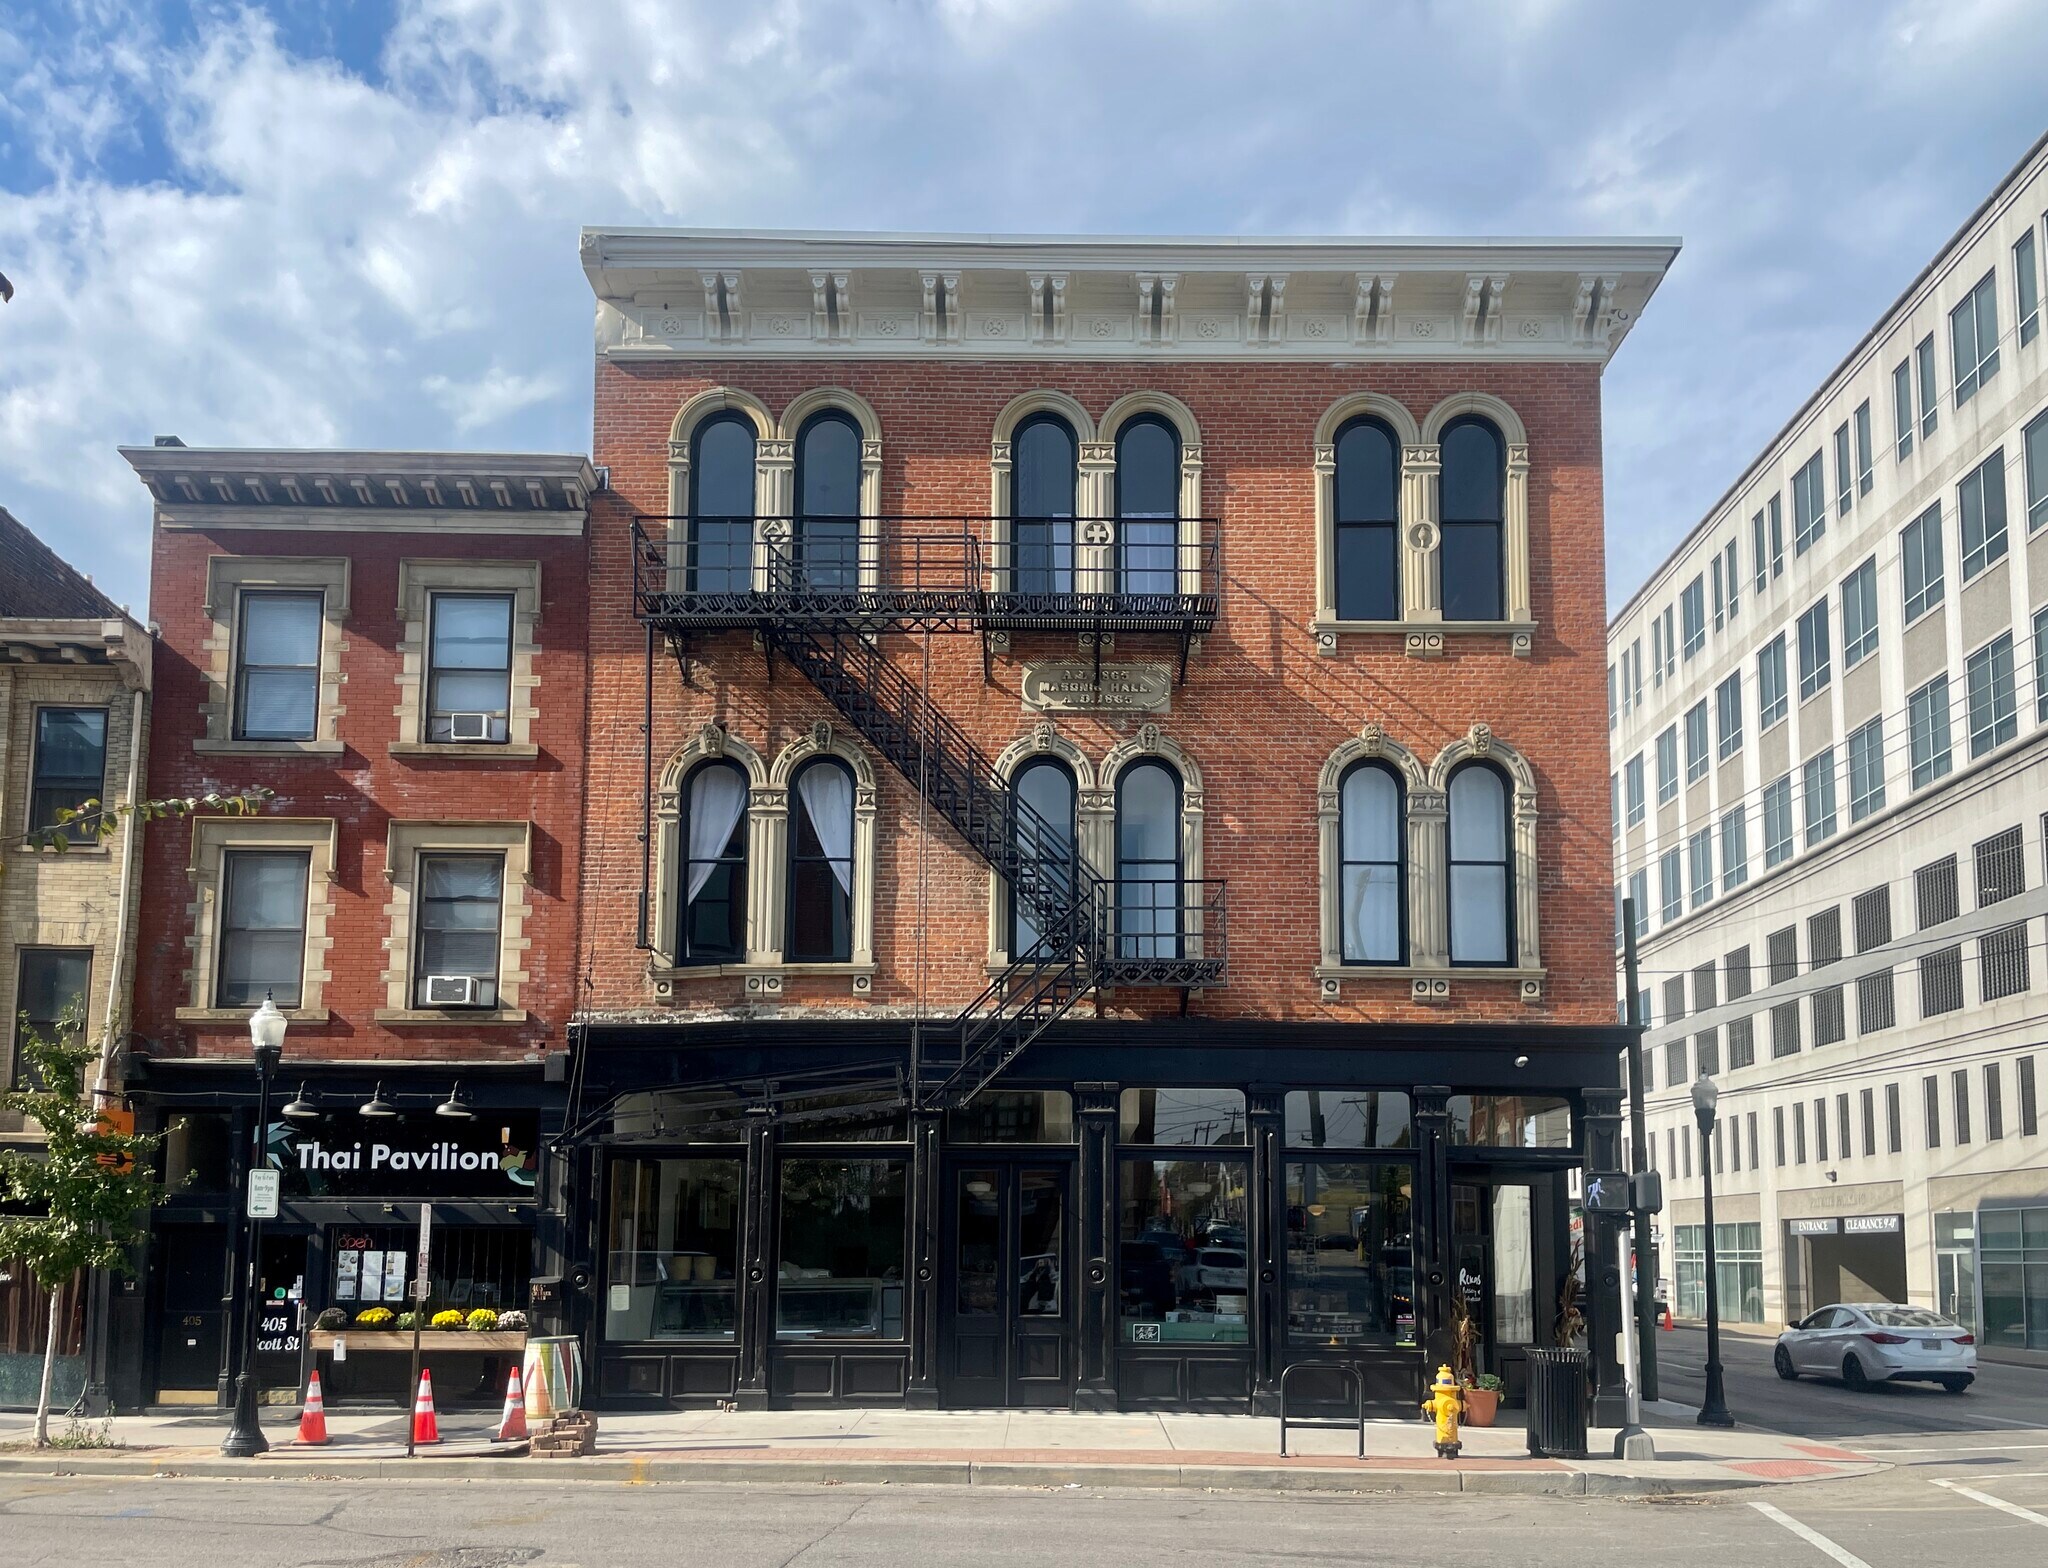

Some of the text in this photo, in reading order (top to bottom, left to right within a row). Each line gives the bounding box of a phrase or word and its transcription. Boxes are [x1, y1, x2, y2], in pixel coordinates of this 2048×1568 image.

[296, 1141, 499, 1170] Thai Pavilion
[1798, 1220, 1829, 1232] ENTRANCE
[1845, 1218, 1884, 1230] CLEARANCE
[182, 1315, 202, 1326] 405
[261, 1317, 288, 1332] 405
[257, 1335, 300, 1351] cott St
